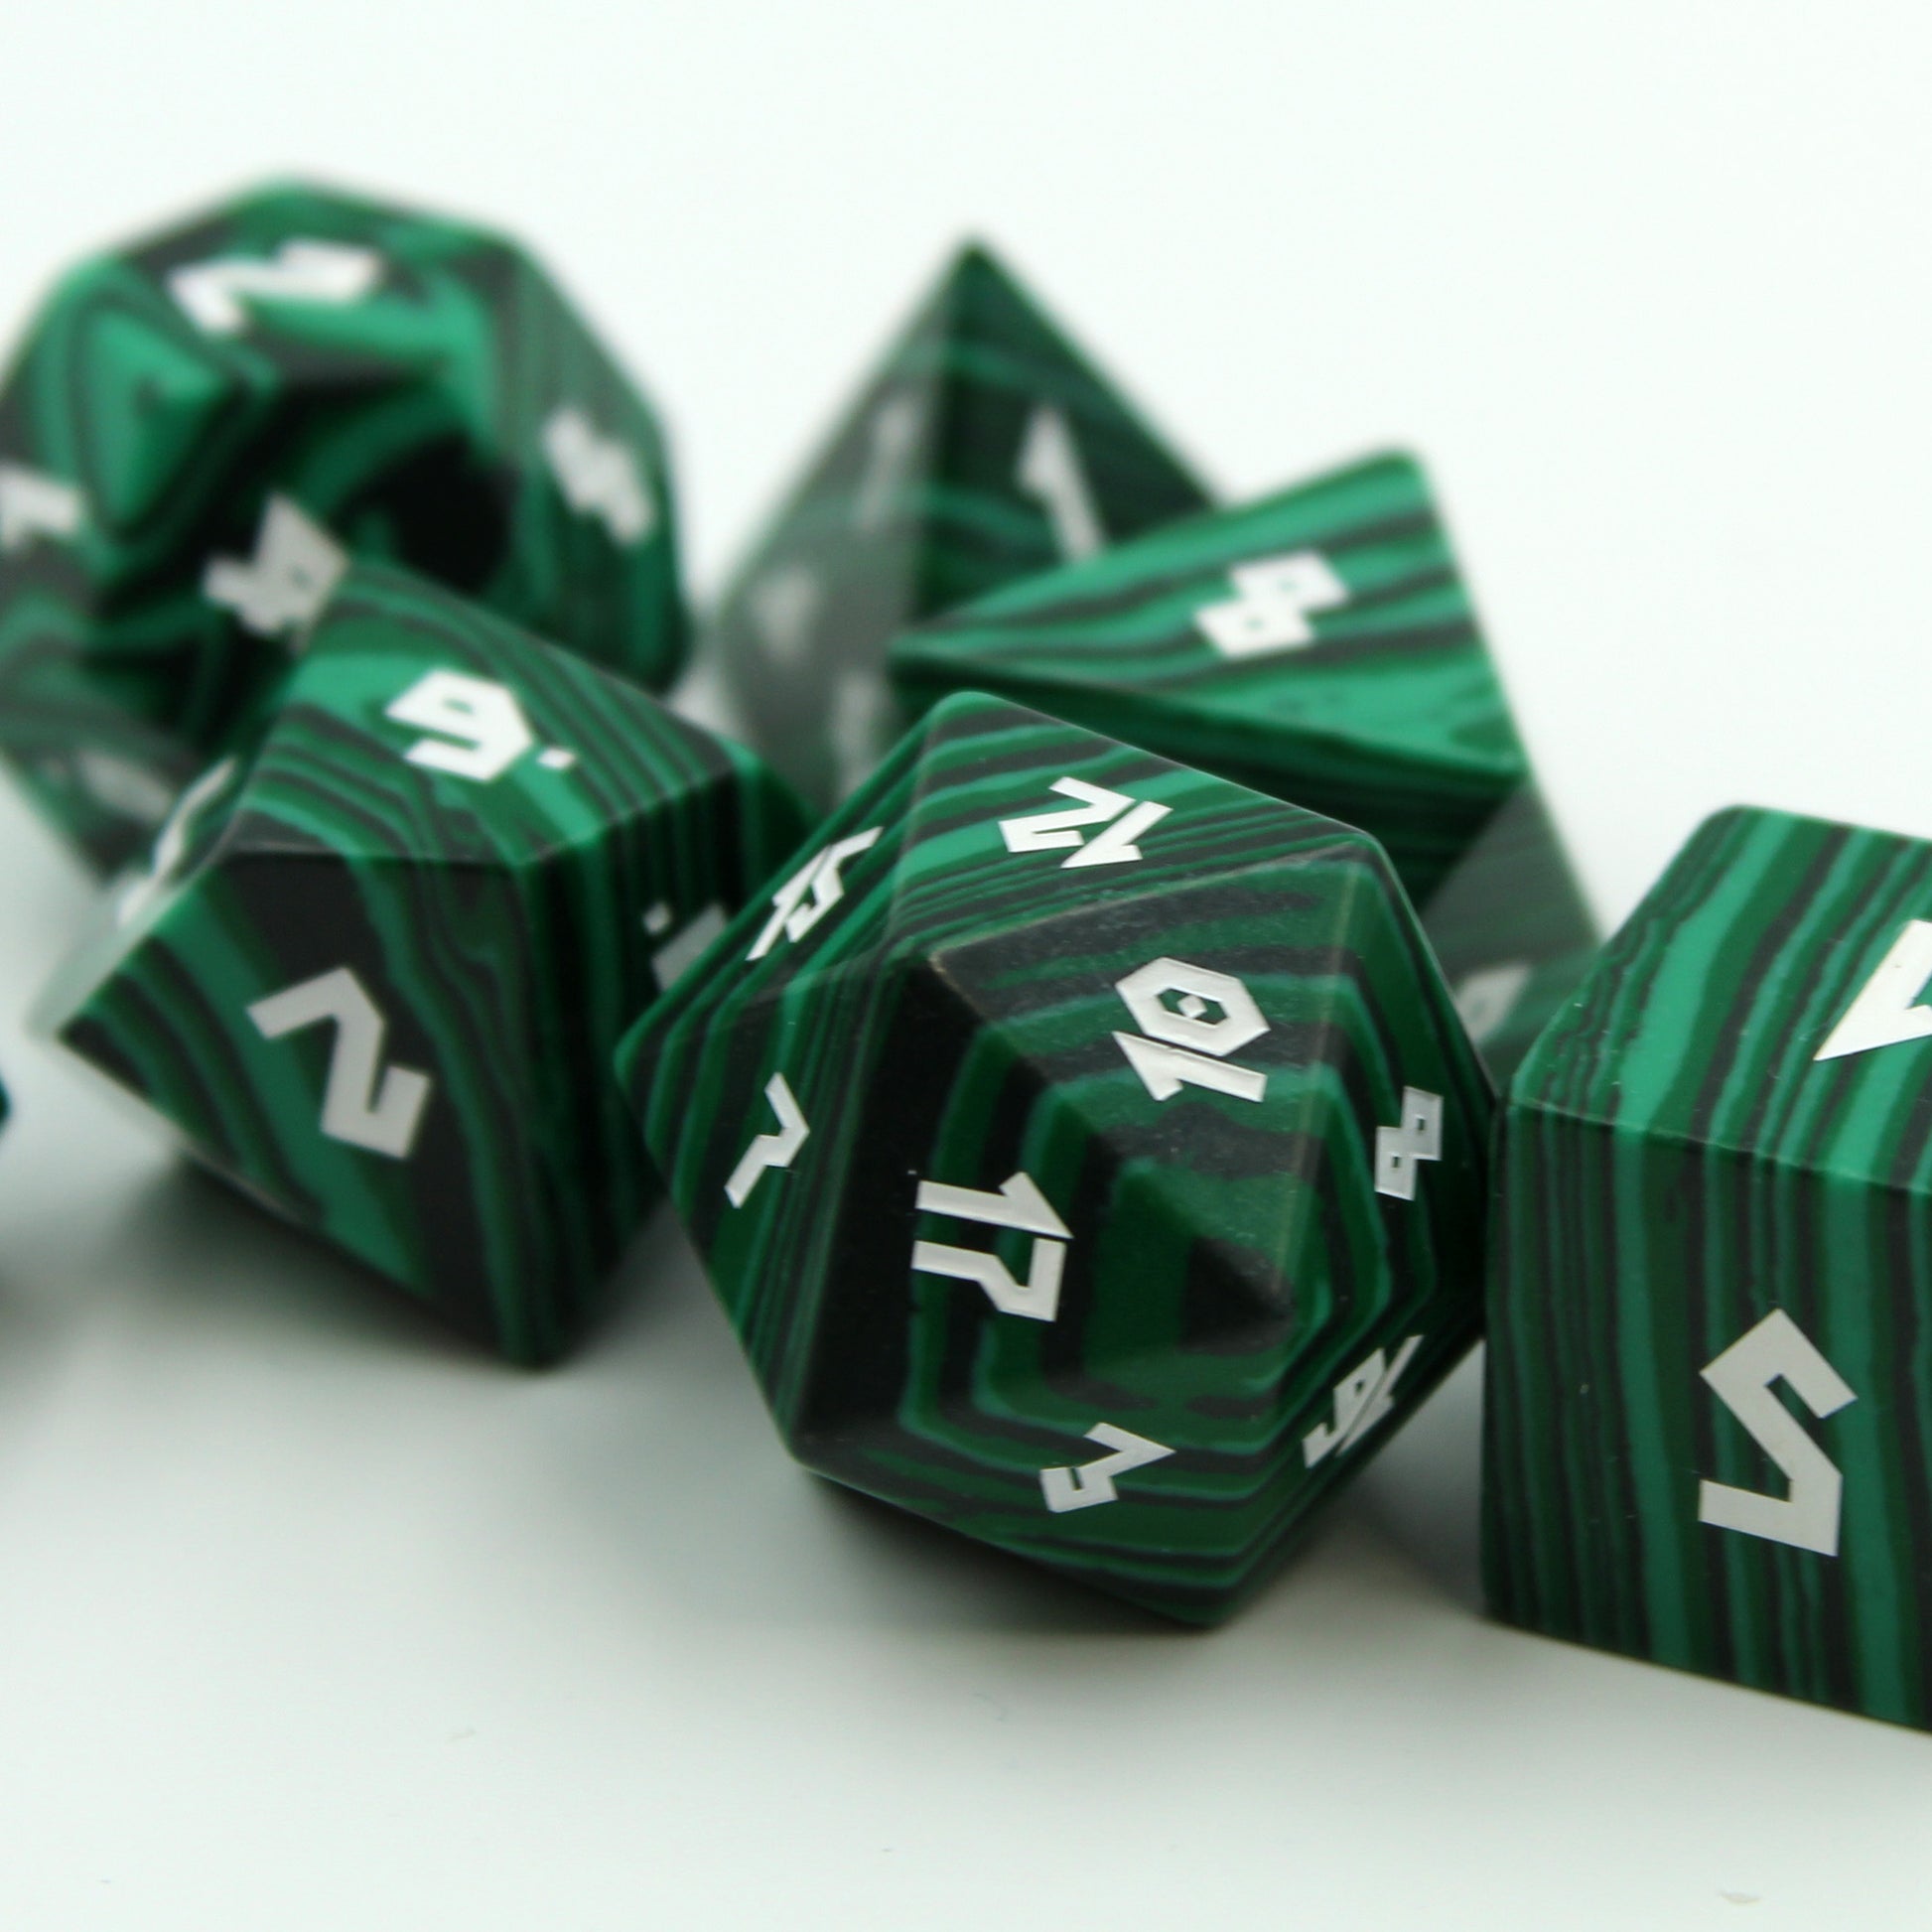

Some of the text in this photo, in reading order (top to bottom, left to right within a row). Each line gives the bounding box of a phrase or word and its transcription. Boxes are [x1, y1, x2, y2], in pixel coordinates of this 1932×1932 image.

[1196, 551, 1348, 659] 8
[248, 966, 431, 1160] 2
[1113, 957, 1270, 1102] 10
[1375, 1088, 1443, 1200] 8
[912, 1173, 1071, 1321] 17
